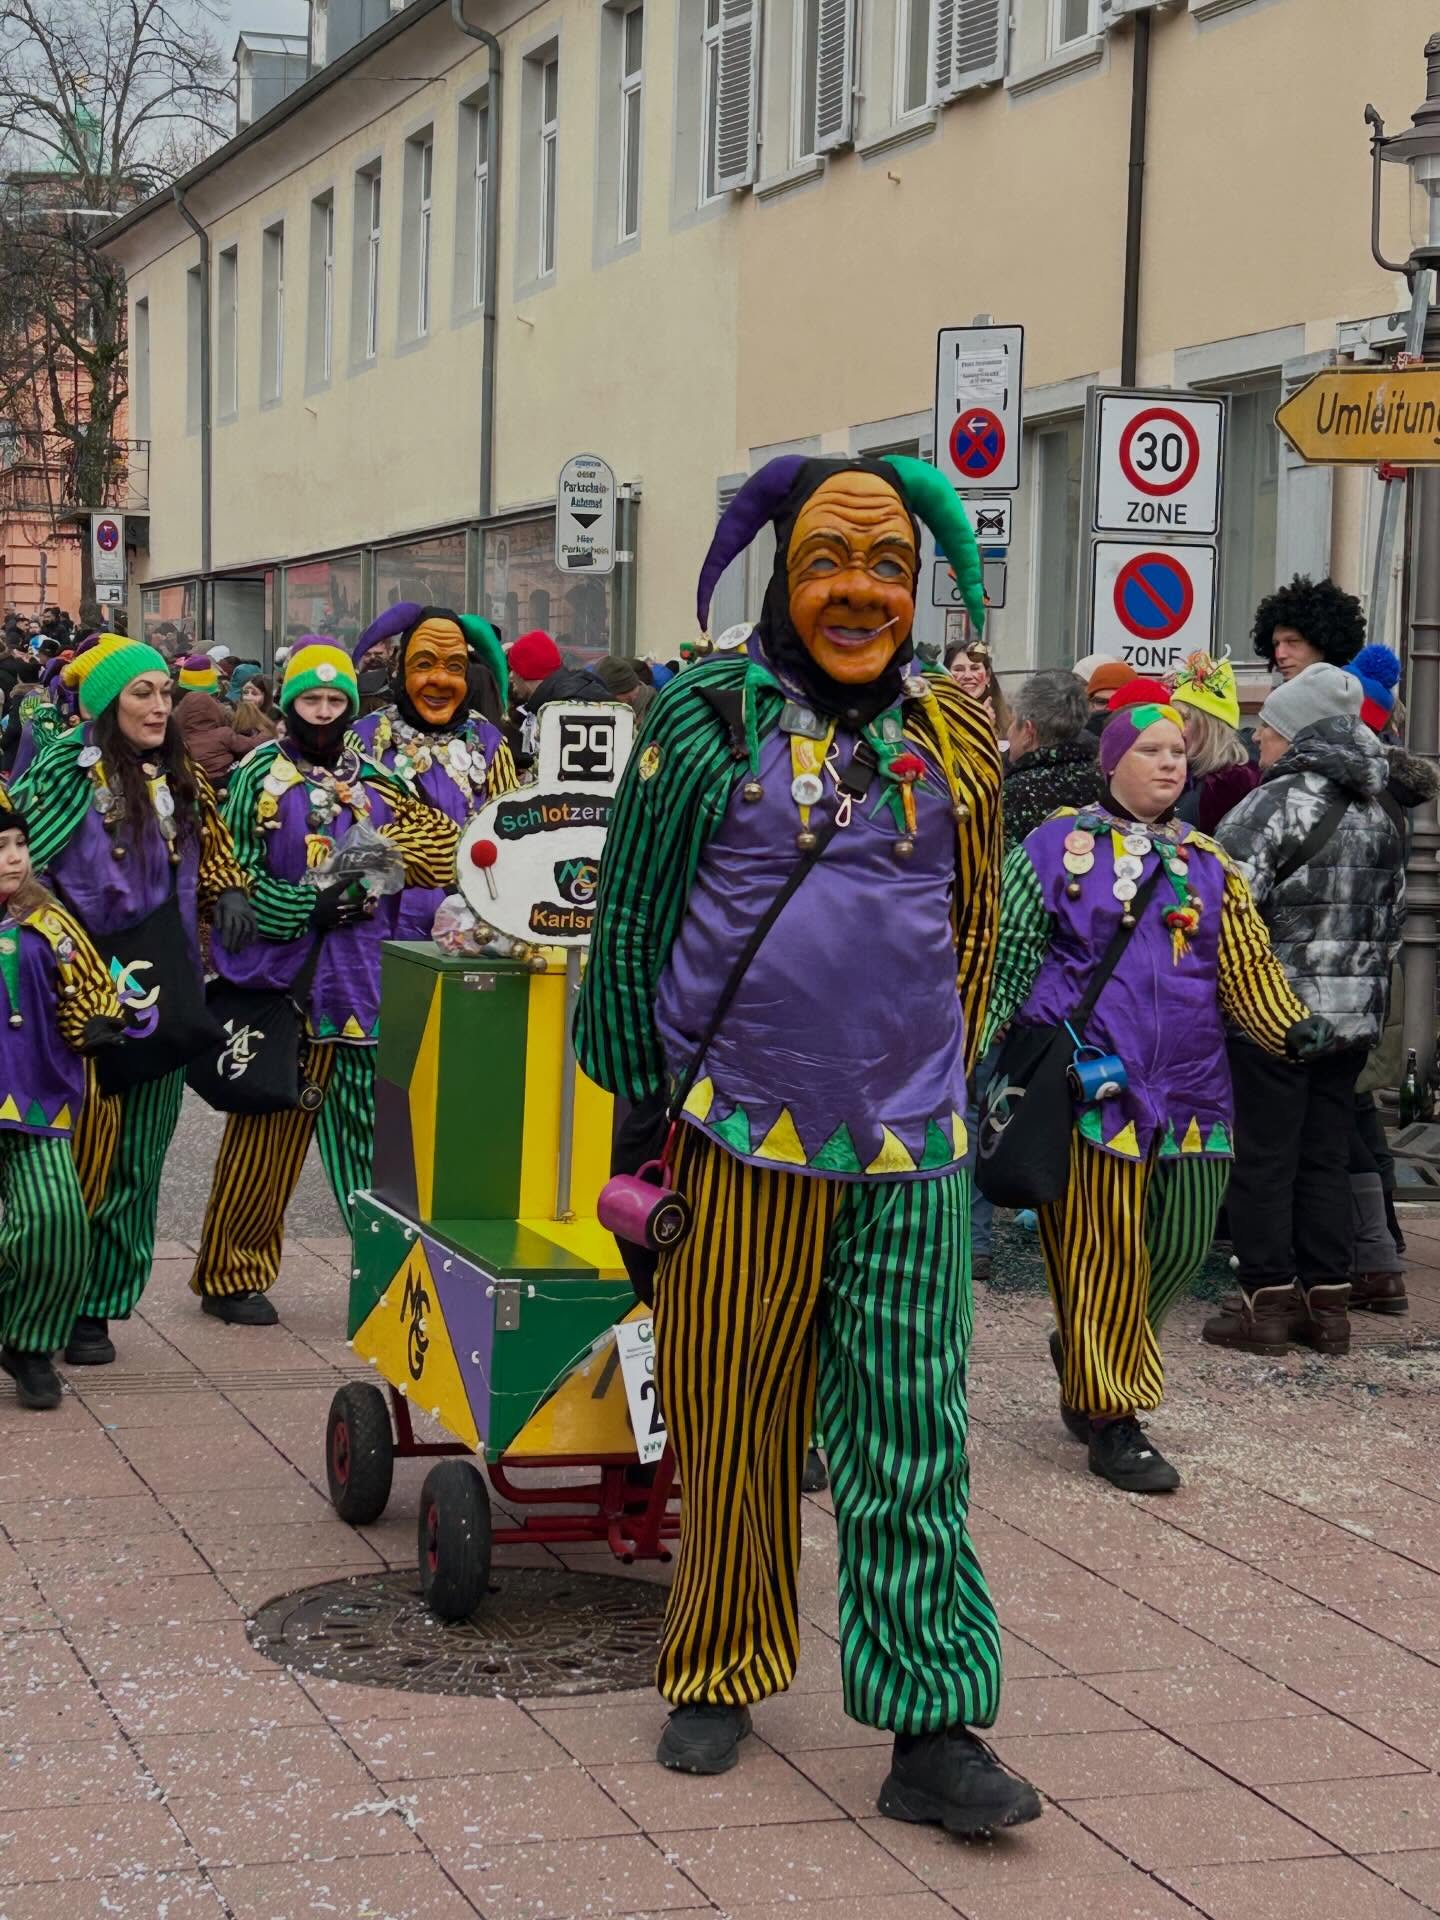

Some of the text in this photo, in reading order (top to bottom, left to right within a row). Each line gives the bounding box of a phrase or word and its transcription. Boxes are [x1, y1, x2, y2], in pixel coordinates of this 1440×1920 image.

[1317, 390, 1440, 444] Umleitun
[1136, 432, 1182, 472] 30
[1127, 502, 1187, 524] ZONE
[562, 724, 613, 772] 29
